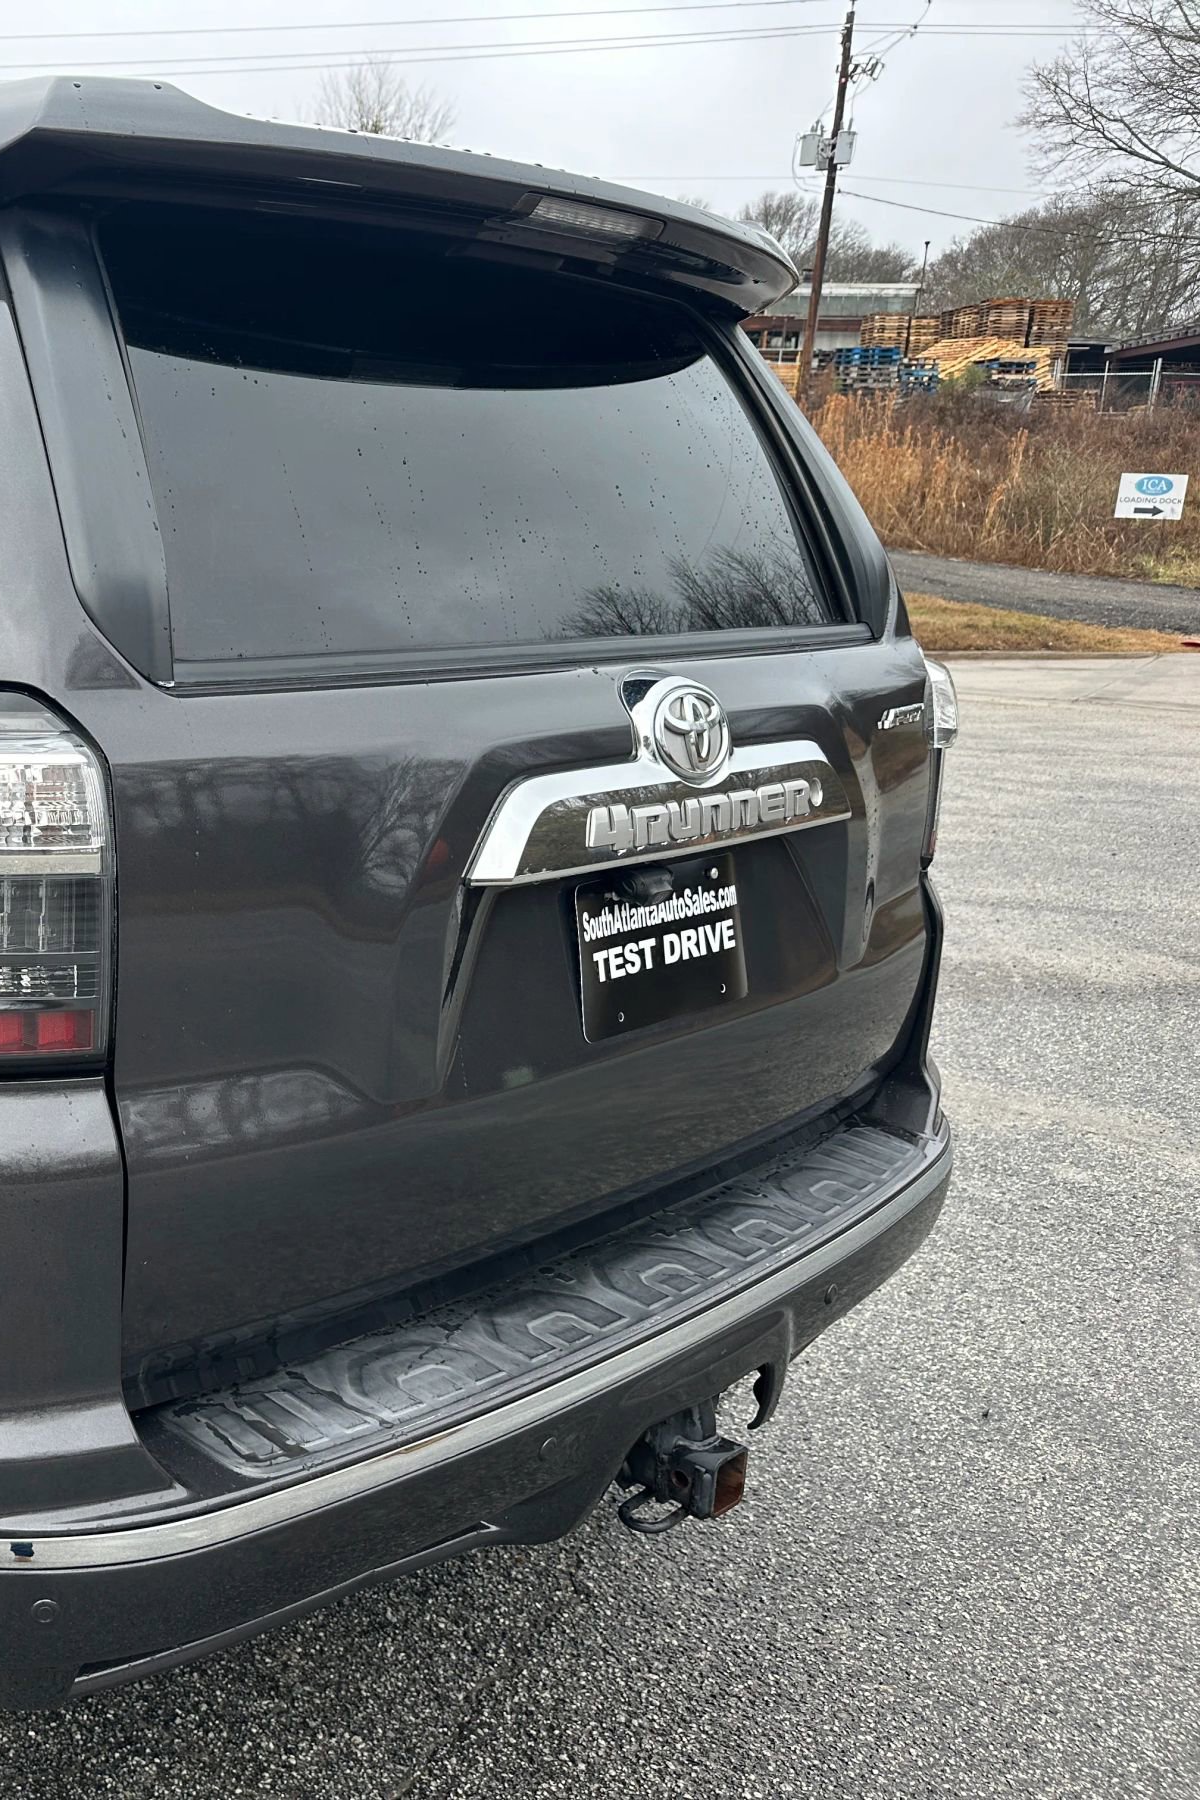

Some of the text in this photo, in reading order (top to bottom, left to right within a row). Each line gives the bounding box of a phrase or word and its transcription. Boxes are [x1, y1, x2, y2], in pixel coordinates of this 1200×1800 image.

[1119, 496, 1183, 505] LOADING DOCK
[1141, 479, 1168, 491] ICA
[585, 778, 810, 852] 4RUNNER
[583, 885, 738, 942] SouthAtlantaAutoSales.com
[593, 919, 736, 983] TEST DRIVE
